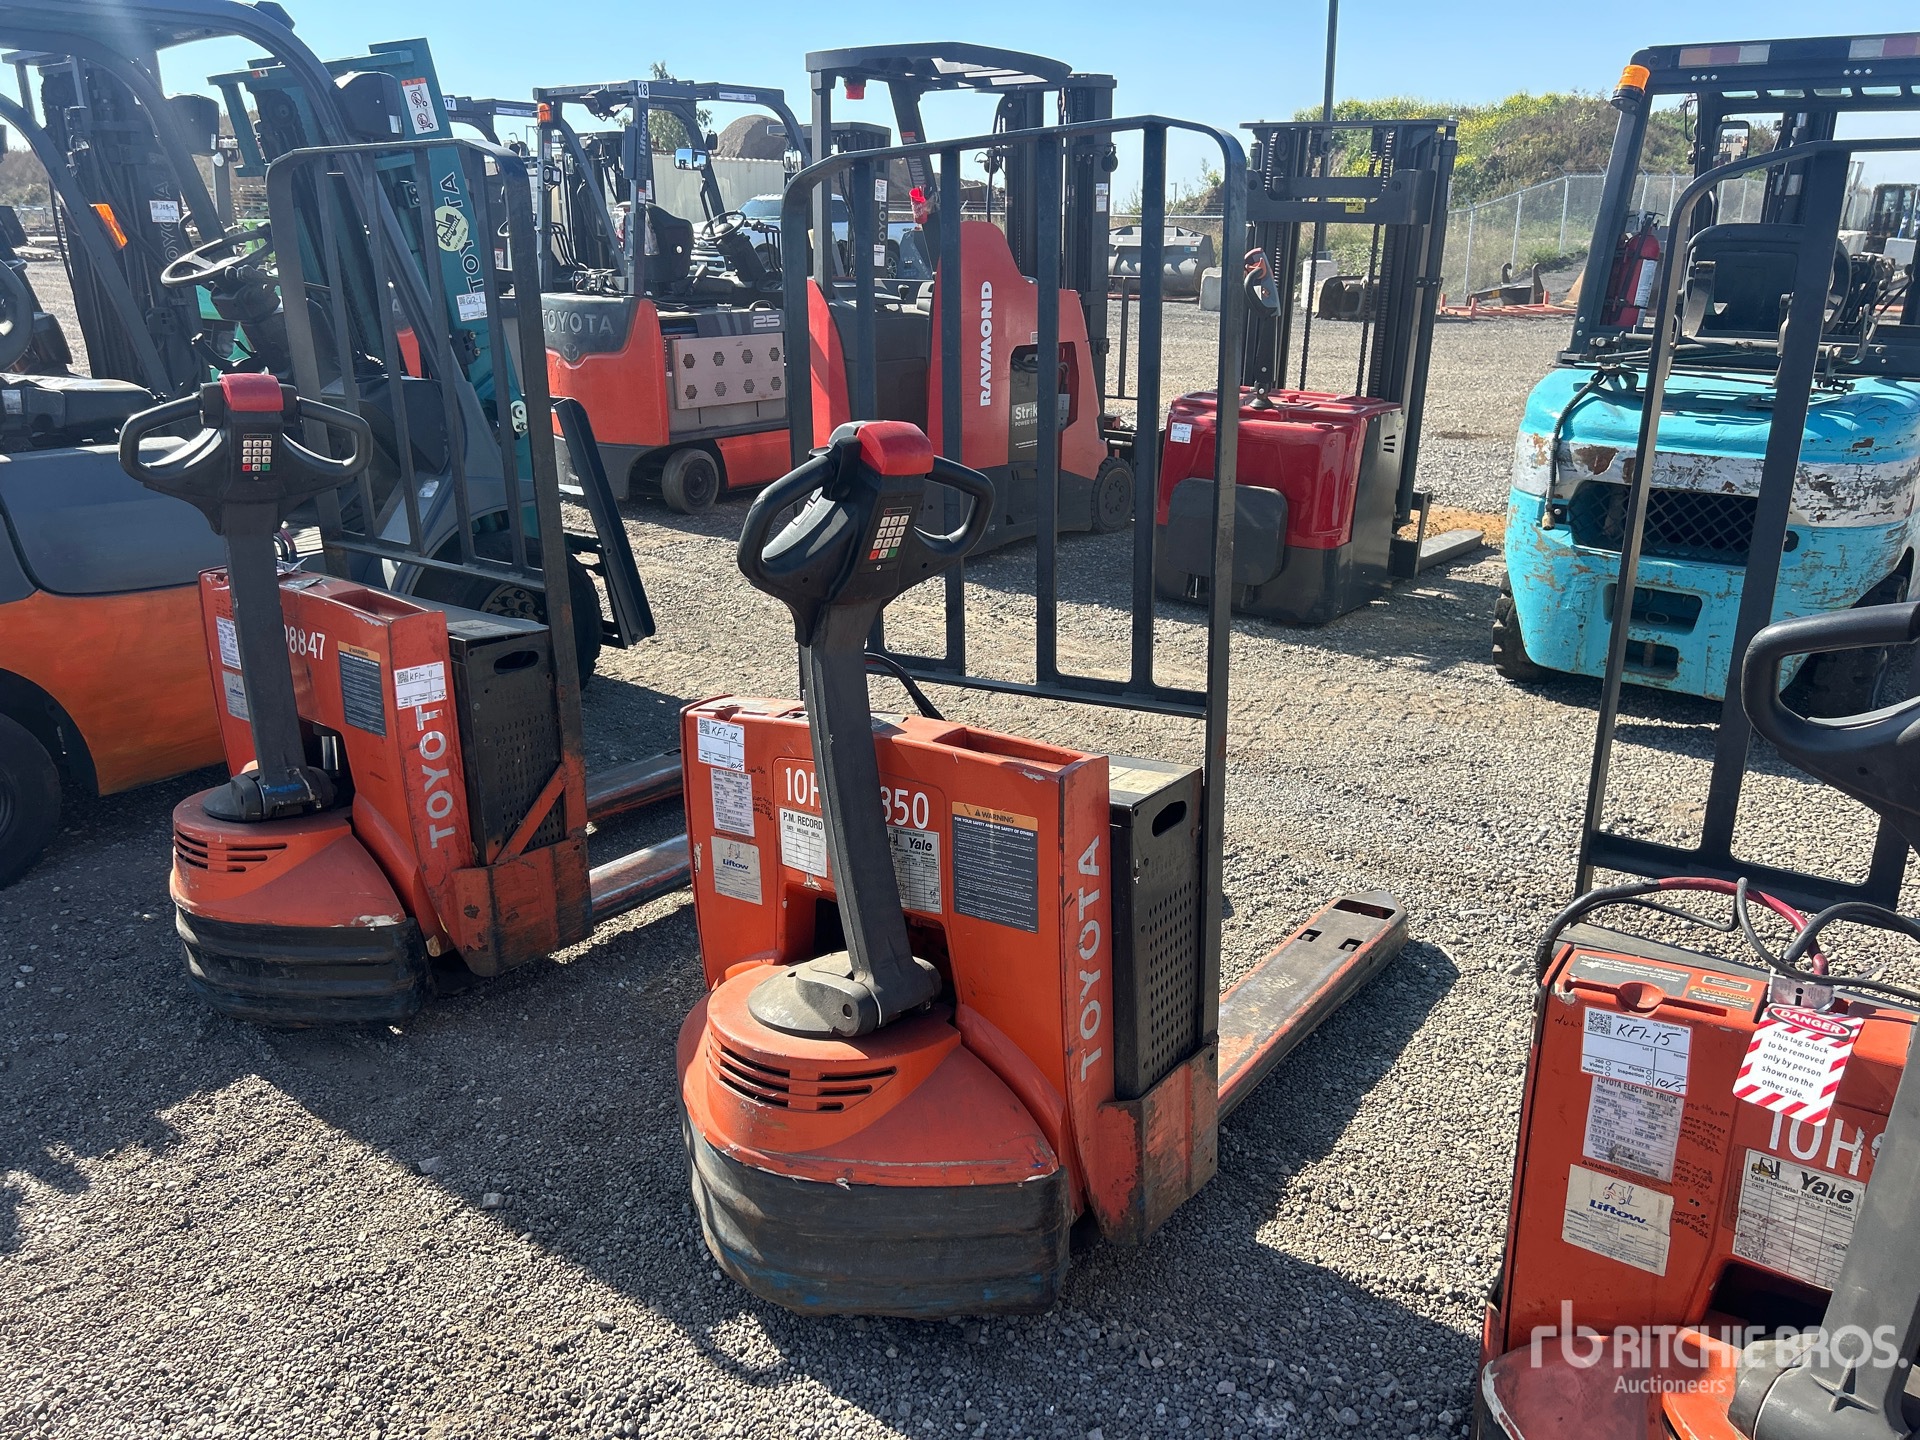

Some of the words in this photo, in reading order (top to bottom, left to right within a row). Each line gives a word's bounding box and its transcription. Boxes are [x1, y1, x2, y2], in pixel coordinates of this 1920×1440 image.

[639, 84, 648, 96] 18
[444, 99, 454, 108] 17
[439, 171, 484, 294] TOYTA
[878, 201, 887, 244] OYOT
[752, 314, 780, 328] 25
[980, 281, 993, 406] RAYMOND
[415, 705, 456, 849] TOYOT
[783, 811, 796, 824] P.M.
[797, 815, 823, 831] RECORD
[962, 817, 973, 825] YOUR
[973, 819, 985, 828] SAFETY
[985, 821, 994, 829] AND
[1001, 825, 1014, 833] SAFETY
[982, 810, 1015, 824] WARNING
[908, 837, 932, 851] Yale
[722, 858, 749, 870] Liftow
[1077, 834, 1102, 1083] TOYOTA
[1654, 968, 1689, 979] Manual
[1779, 1009, 1841, 1034] DANGER
[1772, 1031, 1789, 1041] This
[1790, 1035, 1803, 1047] tag
[1811, 1043, 1829, 1054] lock
[1768, 1041, 1776, 1049] to
[1778, 1043, 1788, 1053] be
[1789, 1049, 1826, 1065] removed
[1589, 1062, 1604, 1070] Video
[1617, 1068, 1645, 1079] Inspection
[1628, 1065, 1645, 1073] Fluids
[1762, 1052, 1781, 1064] only
[1782, 1057, 1792, 1068] by
[1792, 1063, 1822, 1078] person
[1655, 1077, 1688, 1093] 10/5
[1761, 1065, 1787, 1080] shown
[1788, 1074, 1799, 1084] on
[1800, 1077, 1814, 1089] the
[1597, 1076, 1622, 1089] TOYOTA
[1623, 1083, 1654, 1098] ELECTRIC
[1655, 1092, 1678, 1105] TRUCK
[1761, 1079, 1784, 1092] other
[1785, 1087, 1804, 1099] side.
[1768, 1111, 1884, 1176] 10H
[1588, 1161, 1619, 1175] WARNING
[1750, 1173, 1765, 1184] Yale
[1766, 1179, 1799, 1195] Industrial
[1800, 1190, 1824, 1203] Trucks
[1825, 1197, 1853, 1212] Ontario
[1751, 1182, 1765, 1191] DATE
[1801, 1171, 1855, 1204] Yale
[1586, 1208, 1603, 1216] LIFTING
[1589, 1199, 1647, 1224] Liftow
